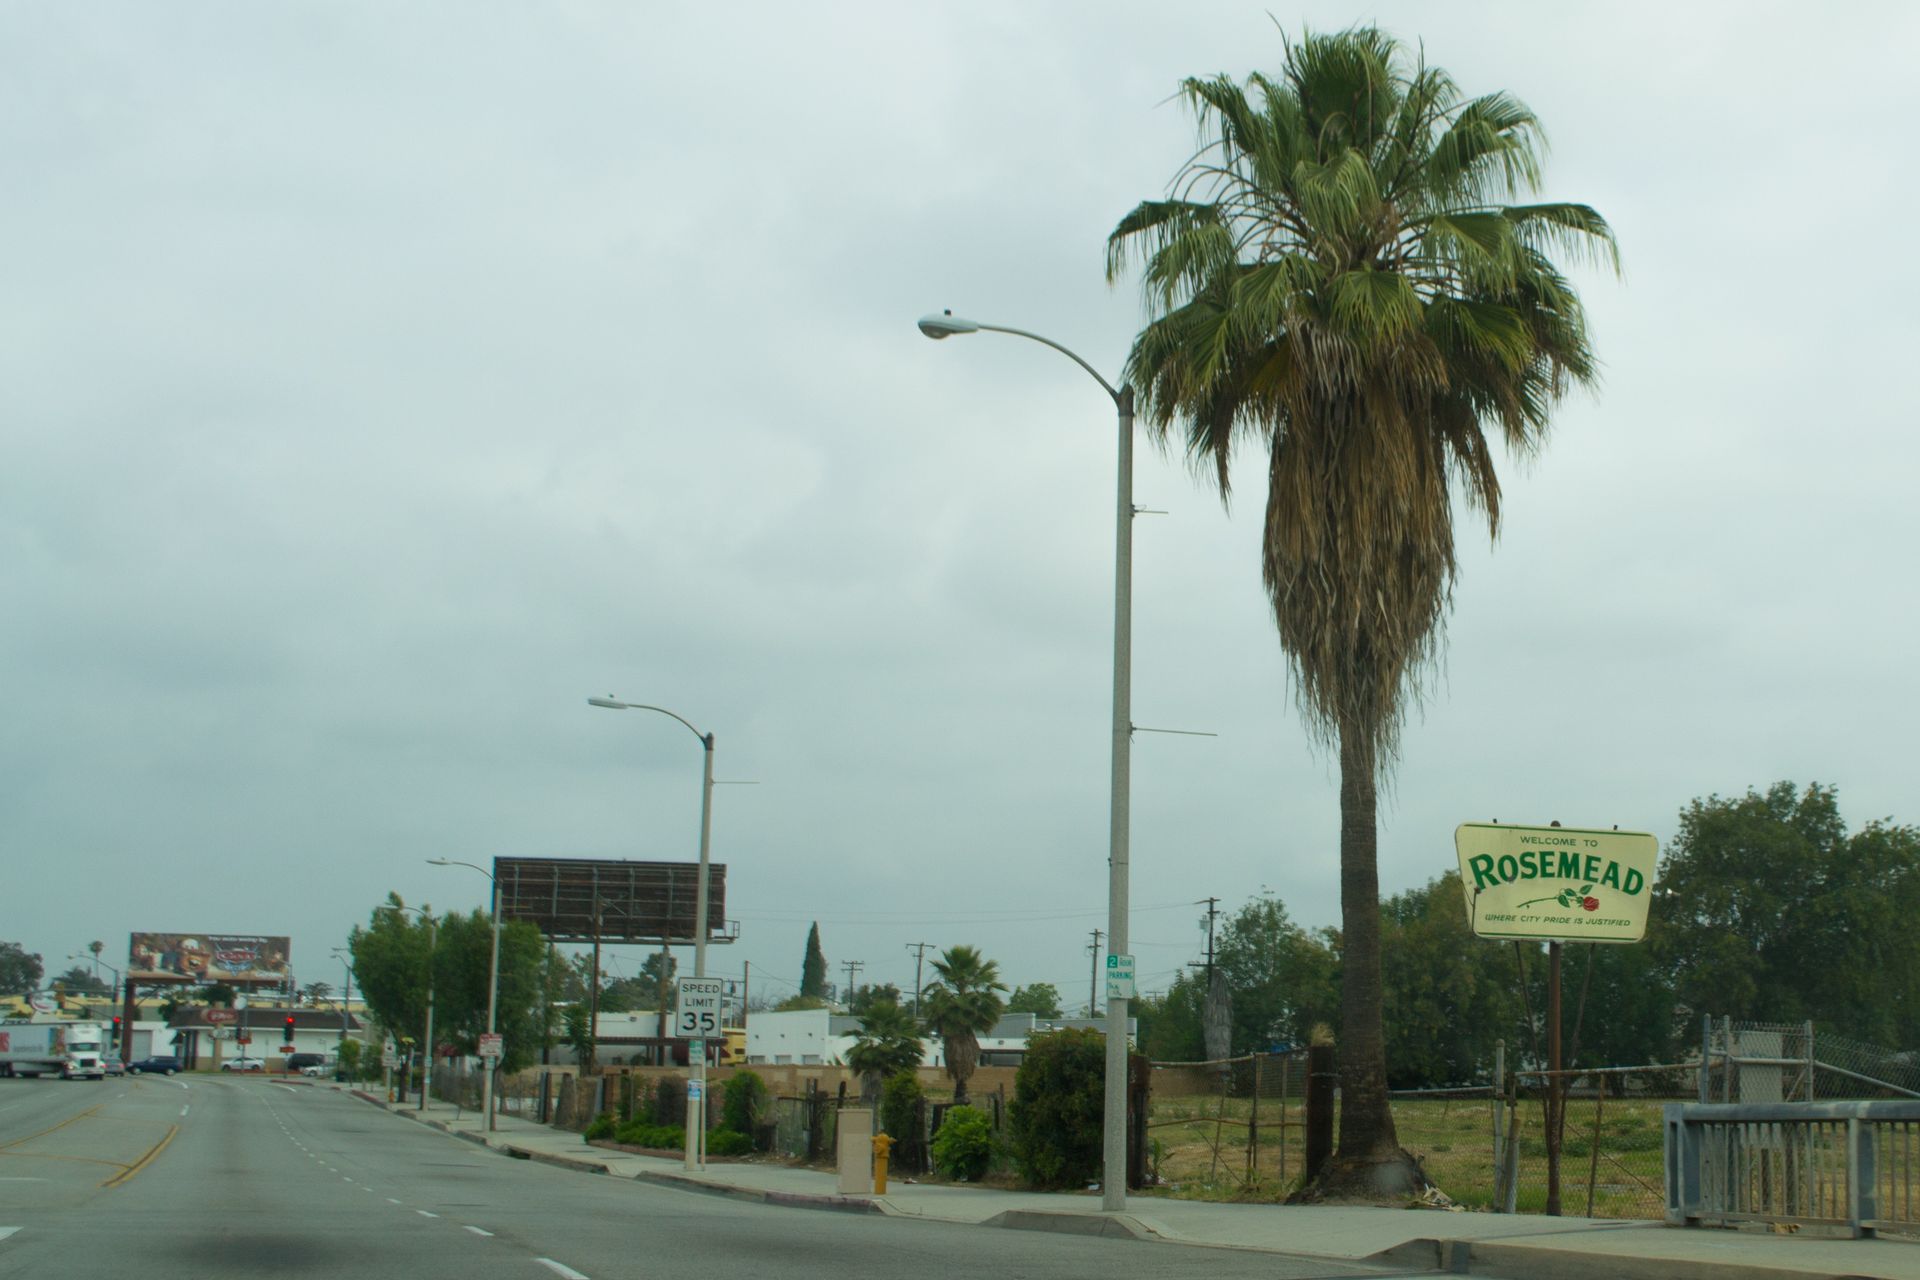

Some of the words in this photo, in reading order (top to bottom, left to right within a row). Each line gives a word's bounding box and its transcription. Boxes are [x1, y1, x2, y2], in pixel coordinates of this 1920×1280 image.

[1520, 836, 1577, 846] WELCOME
[1584, 839, 1599, 848] TO
[1468, 851, 1644, 896] ROSEMEAD
[1485, 914, 1517, 922] WHERE
[1520, 915, 1540, 923] CITY
[1543, 916, 1571, 924] PRIDE
[1586, 917, 1631, 927] JUSTIFIED
[1109, 956, 1117, 968] 2
[1108, 971, 1133, 980] PARKING
[682, 983, 720, 994] SPEED
[685, 998, 715, 1008] LIMIT
[682, 1012, 715, 1031] 35
